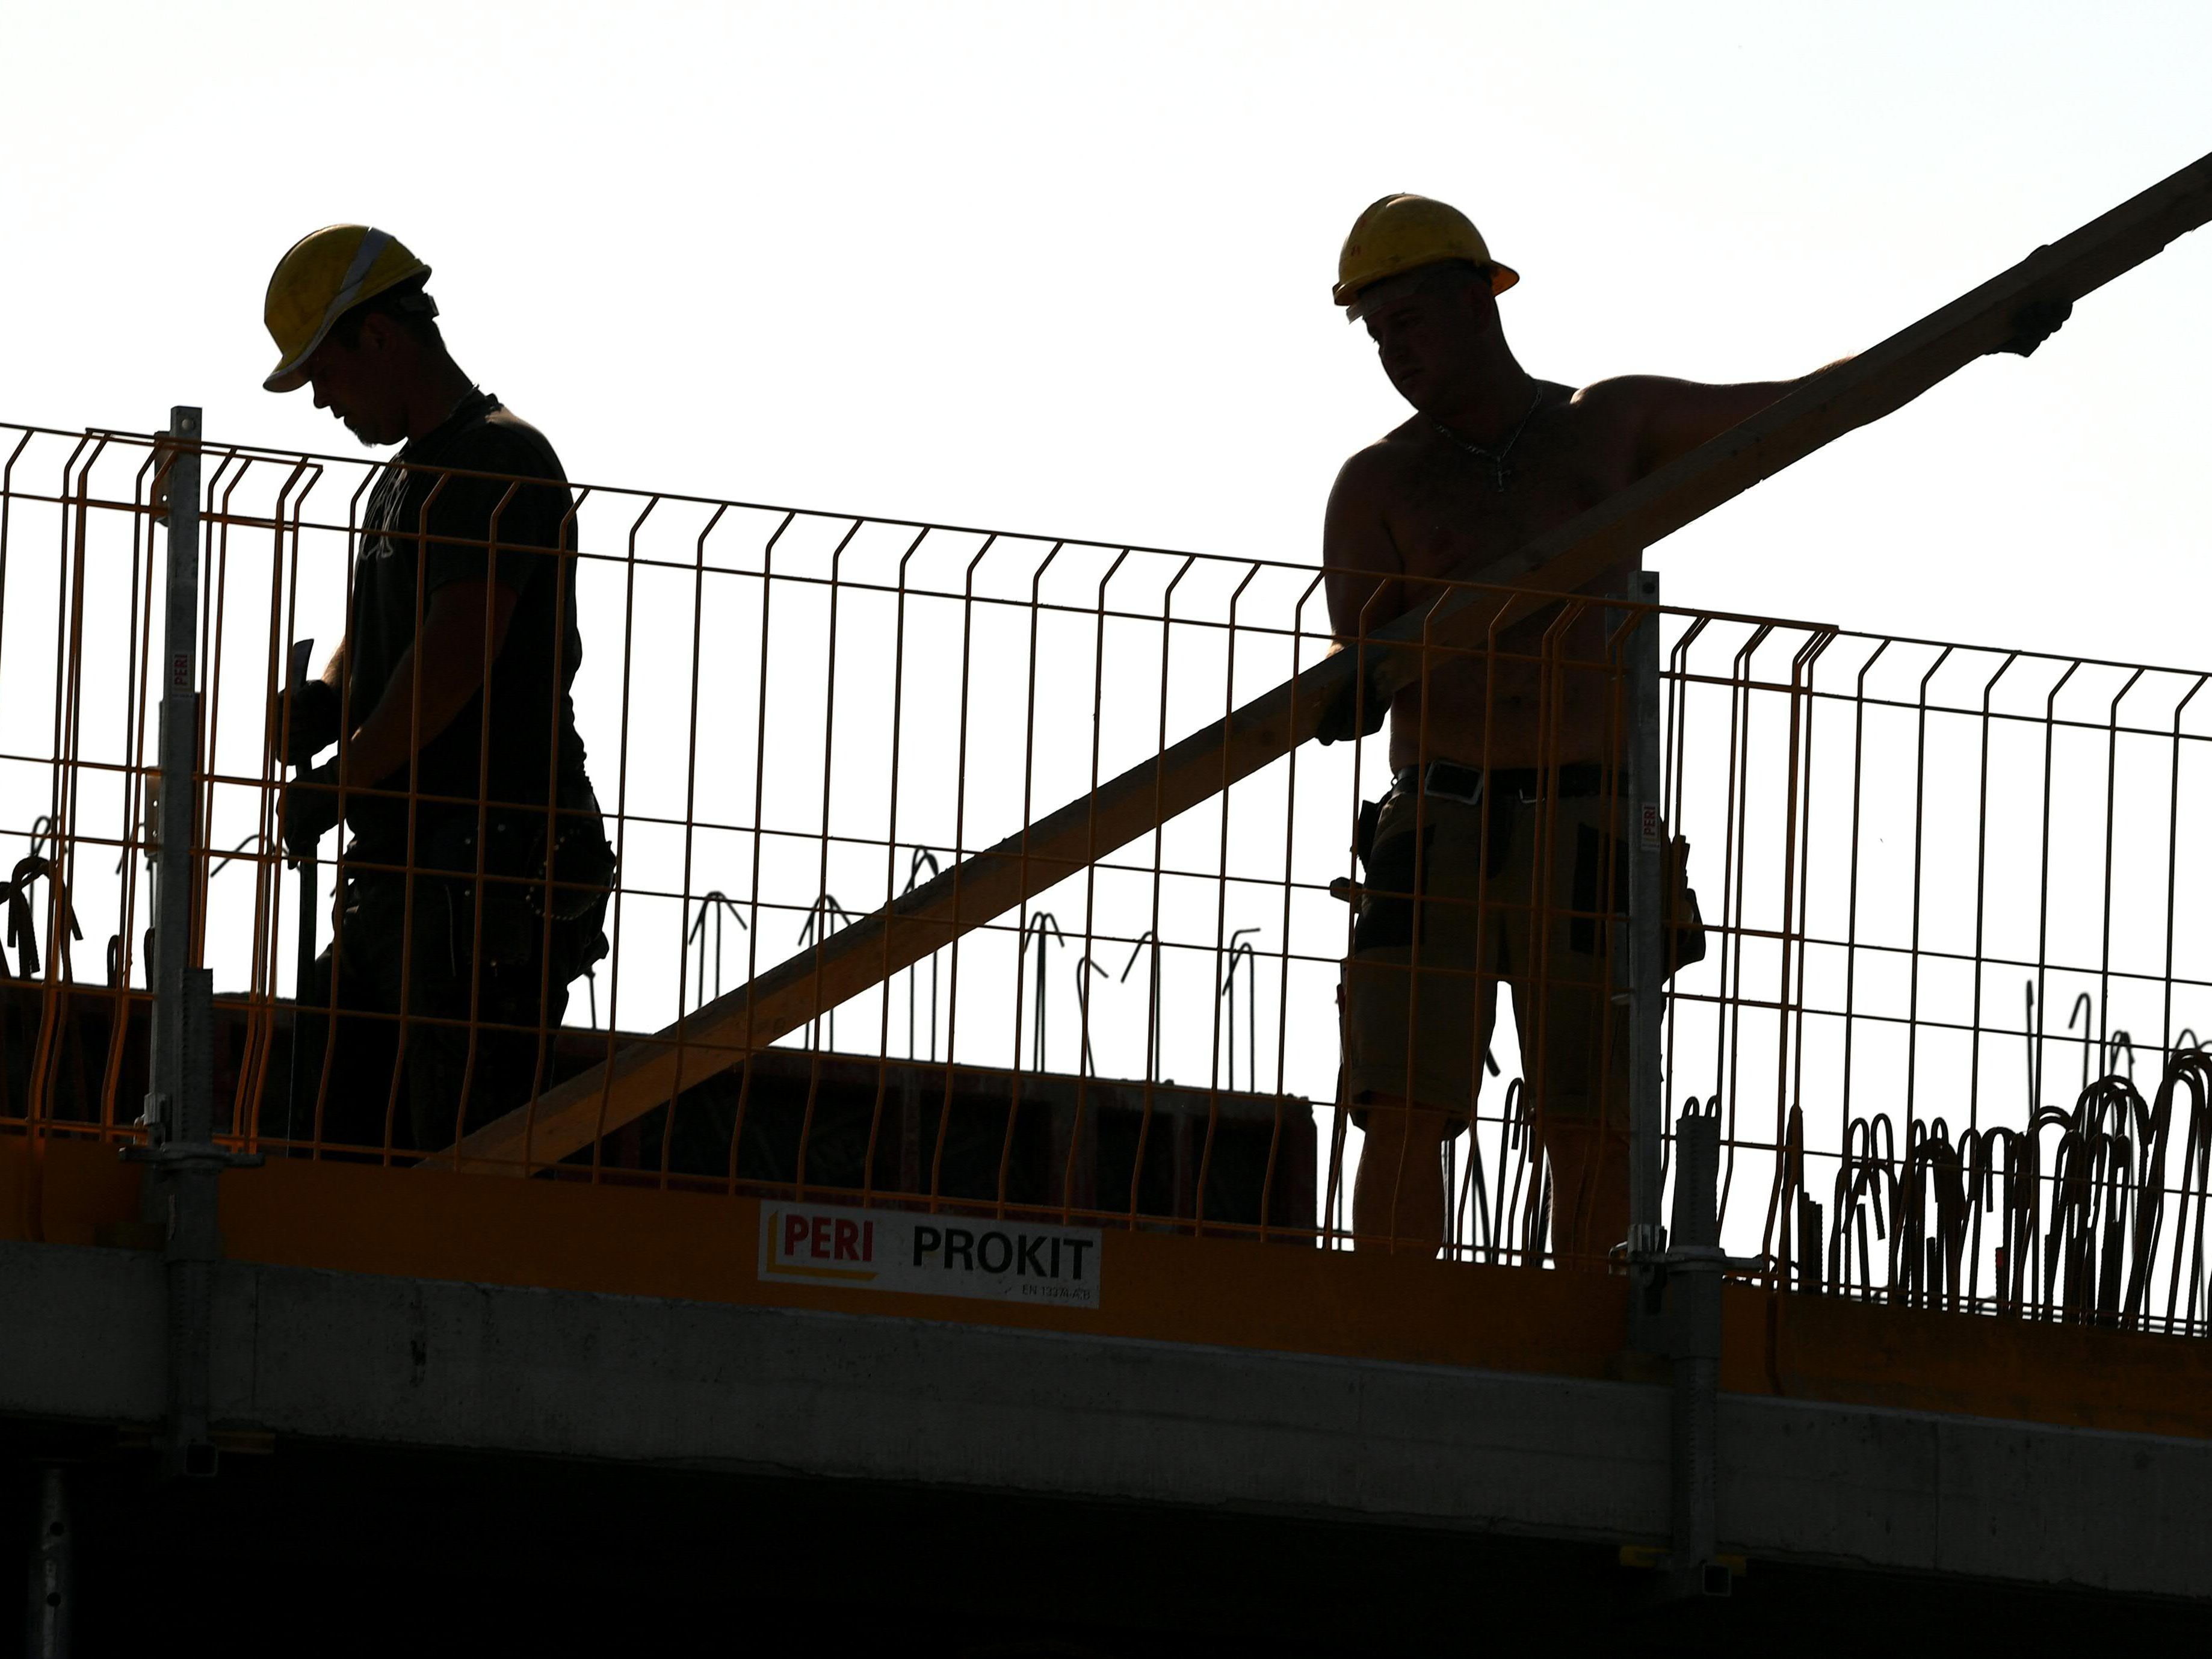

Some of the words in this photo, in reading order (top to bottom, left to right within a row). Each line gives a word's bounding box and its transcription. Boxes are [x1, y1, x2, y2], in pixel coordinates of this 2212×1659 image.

[174, 654, 188, 685] PERI
[1643, 806, 1656, 836] PERI
[784, 1214, 874, 1262] PERI
[912, 1225, 1094, 1281] PROKIT
[1022, 1284, 1037, 1296] EN
